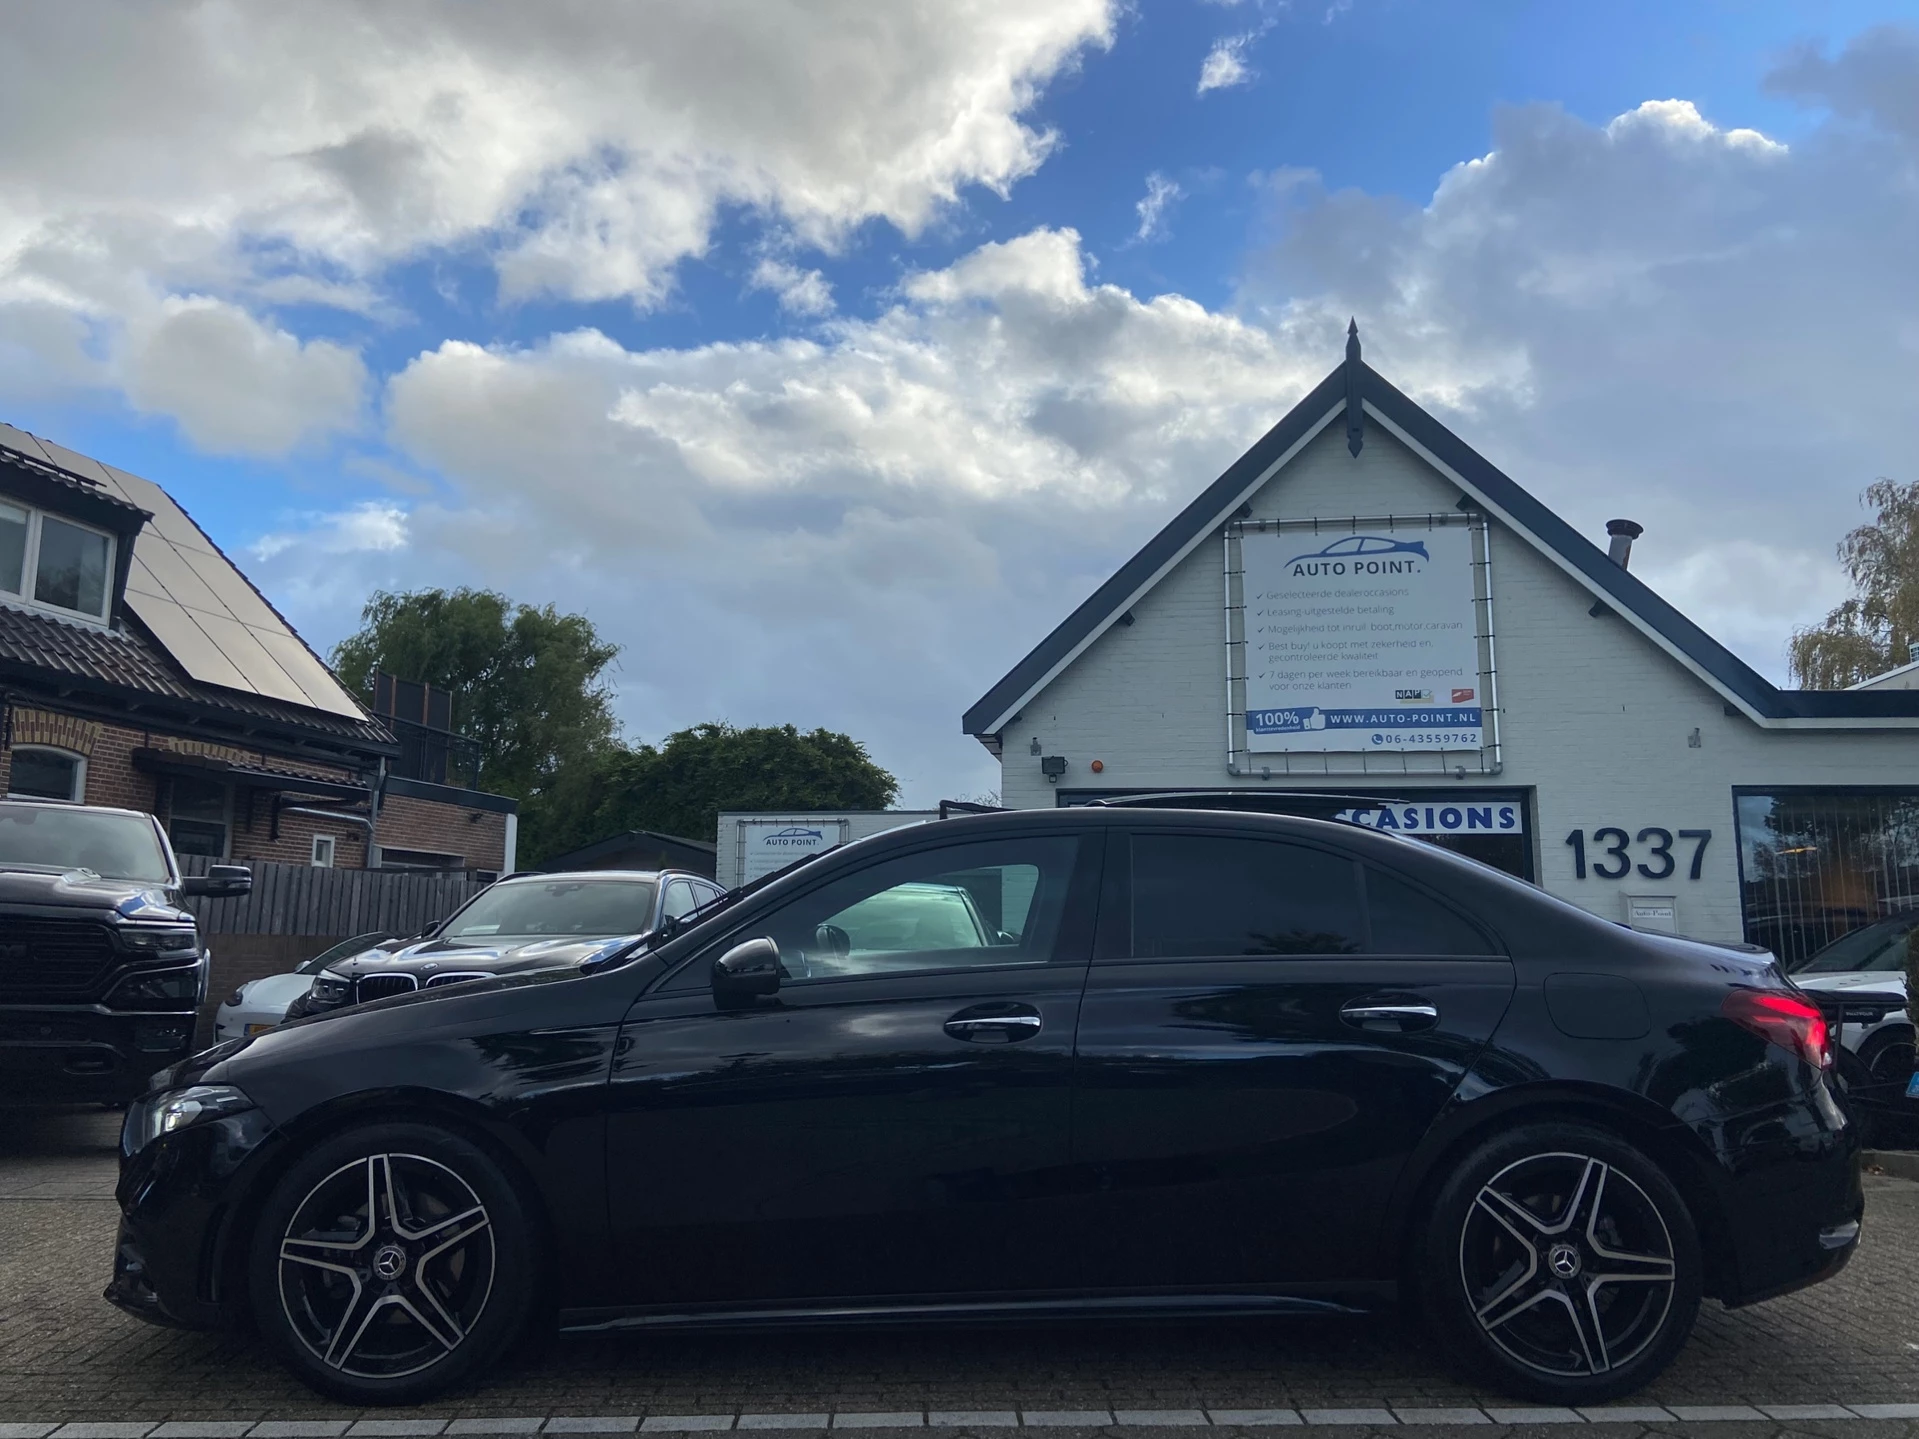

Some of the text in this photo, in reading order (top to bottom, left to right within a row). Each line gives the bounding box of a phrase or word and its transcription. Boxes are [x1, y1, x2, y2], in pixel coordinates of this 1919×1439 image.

[1293, 560, 1421, 576] AUTO POINT.
[1266, 588, 1410, 600] Geselecteerde dealeroccasions
[1357, 605, 1395, 616] betaling
[1268, 624, 1325, 636] Mogelijkheid
[1327, 624, 1340, 633] tot
[1268, 642, 1289, 651] Best
[1321, 640, 1348, 652] koopt
[1350, 641, 1368, 649] met
[1371, 639, 1417, 649] zekerheid
[1268, 651, 1379, 665] gecontroleerde kwaliteit
[1269, 667, 1463, 681] 7 dagen per week bereikbaar en geopend
[1269, 681, 1352, 691] voor onze klanten
[1396, 690, 1421, 699] NAP
[1256, 711, 1300, 726] 100%
[1330, 713, 1477, 725] WWW.AUTO-POINT.NL
[1385, 733, 1477, 744] 06-43559762
[1565, 827, 1712, 880] 1337
